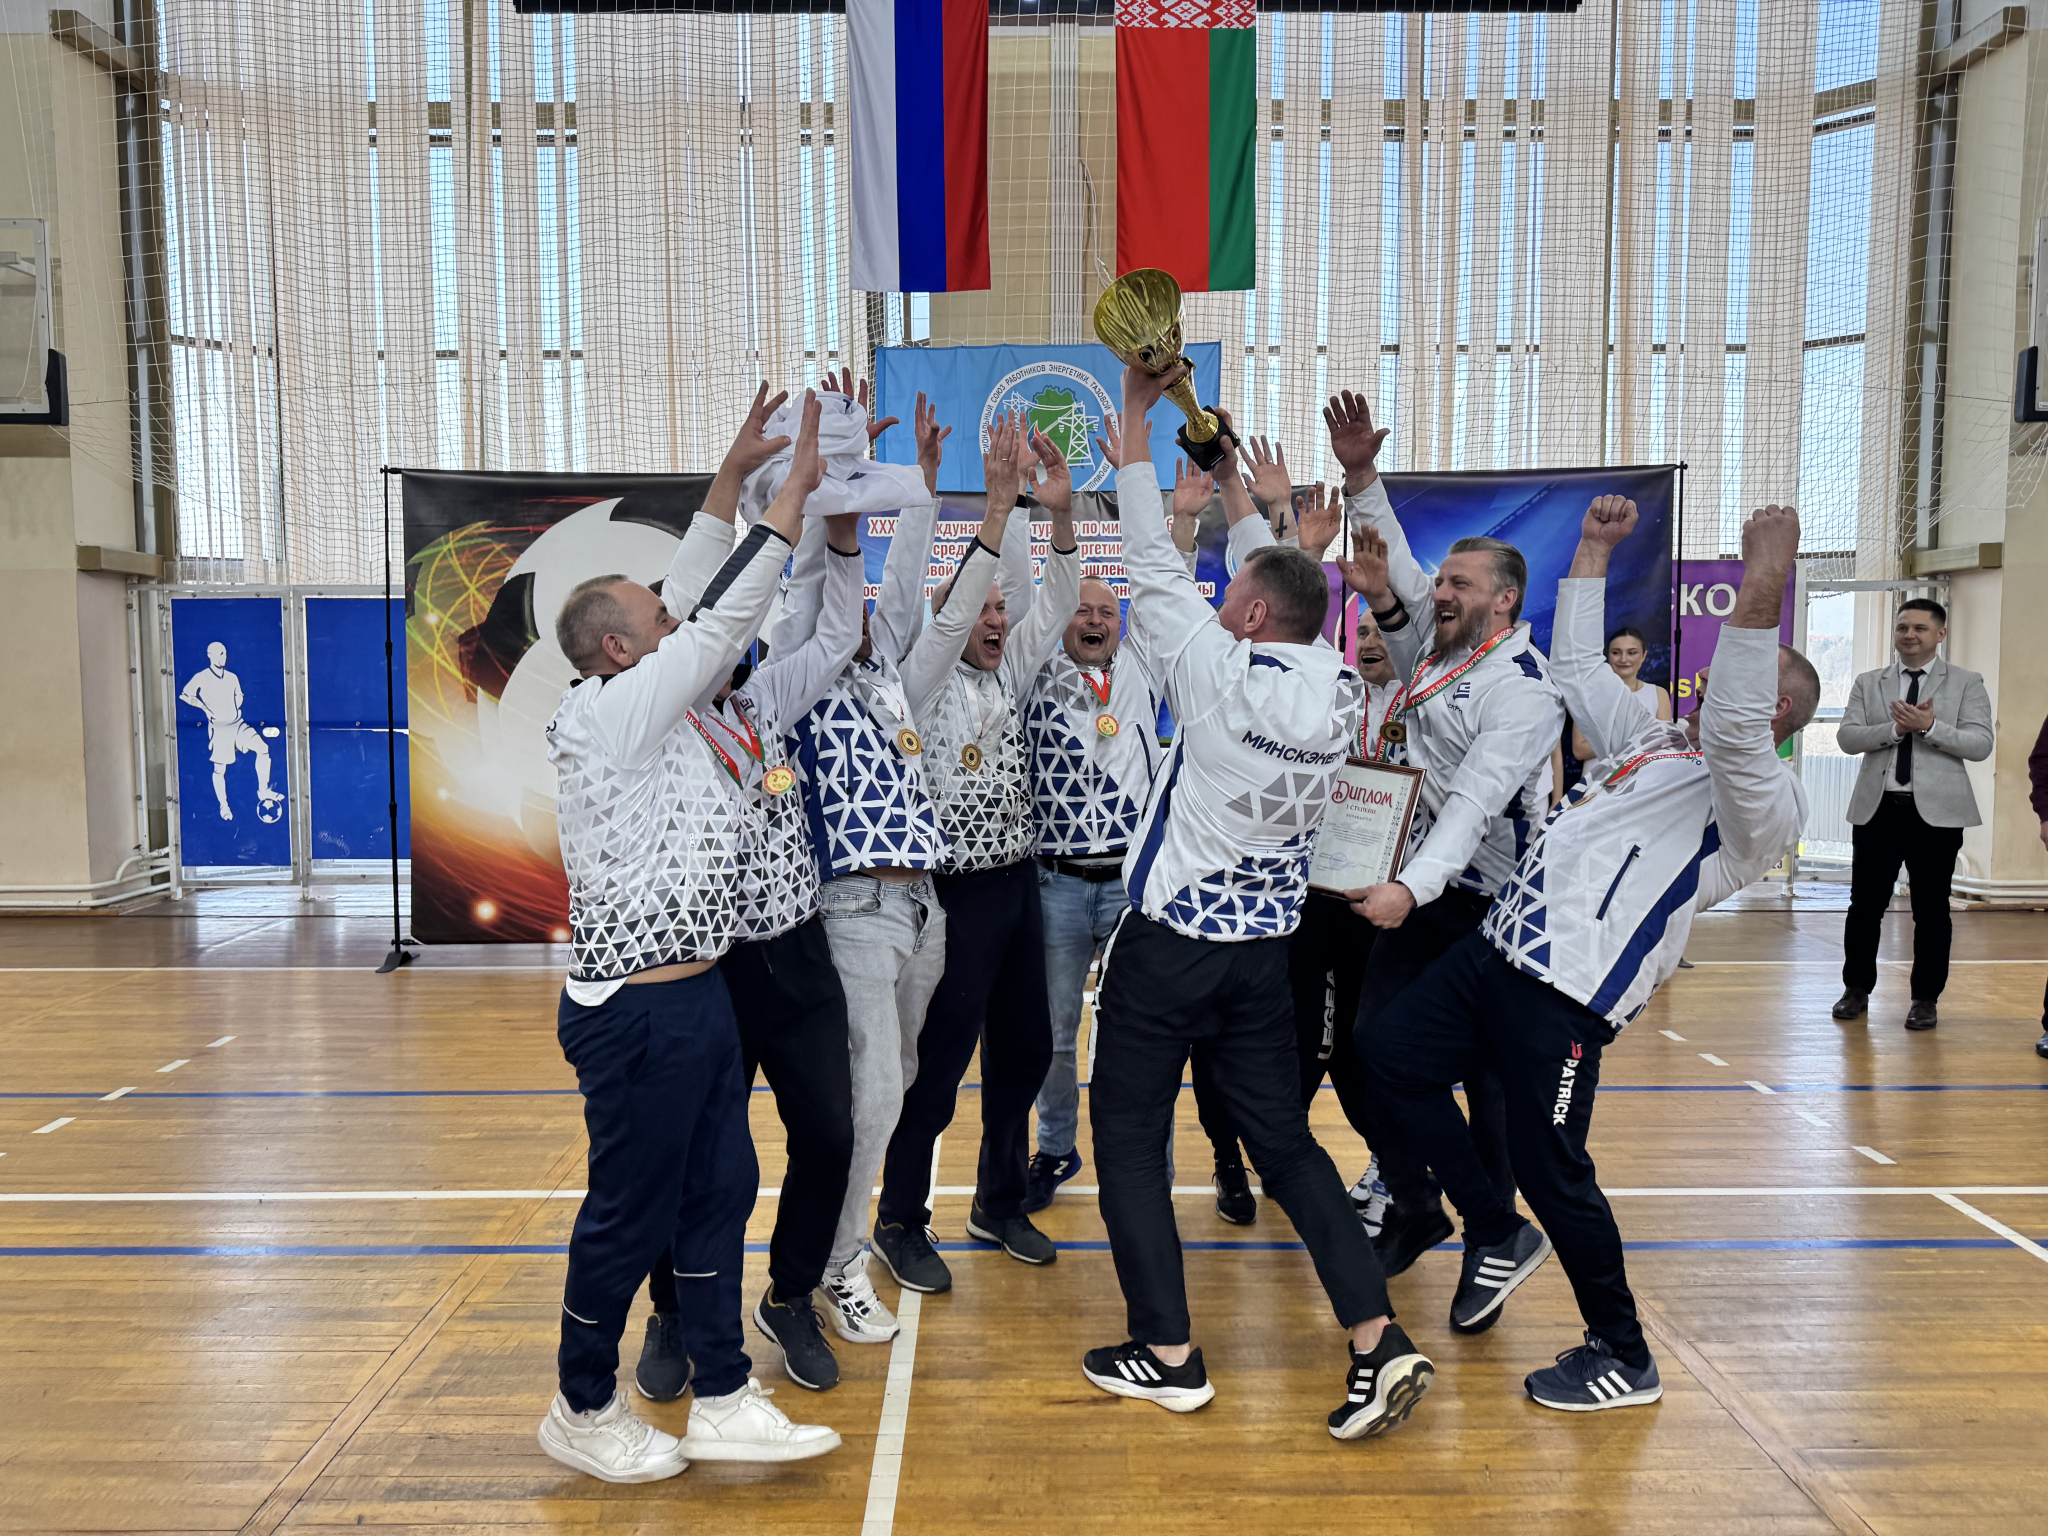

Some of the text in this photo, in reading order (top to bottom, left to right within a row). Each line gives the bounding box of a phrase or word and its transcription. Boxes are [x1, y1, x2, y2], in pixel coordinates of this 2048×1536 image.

[981, 404, 994, 453] СИОНАЛЬНЫЙ
[990, 384, 1006, 403] СОЮЗ
[1005, 364, 1046, 386] РАБОТНИКОВ
[1090, 381, 1113, 411] ГАЗОВОЙ
[870, 519, 899, 535] XXX
[1082, 522, 1098, 535] по
[1451, 650, 1487, 680] БЕЛАРУСЬ
[1317, 968, 1336, 1060] LEGEA
[1553, 1058, 1580, 1126] PATRICK
